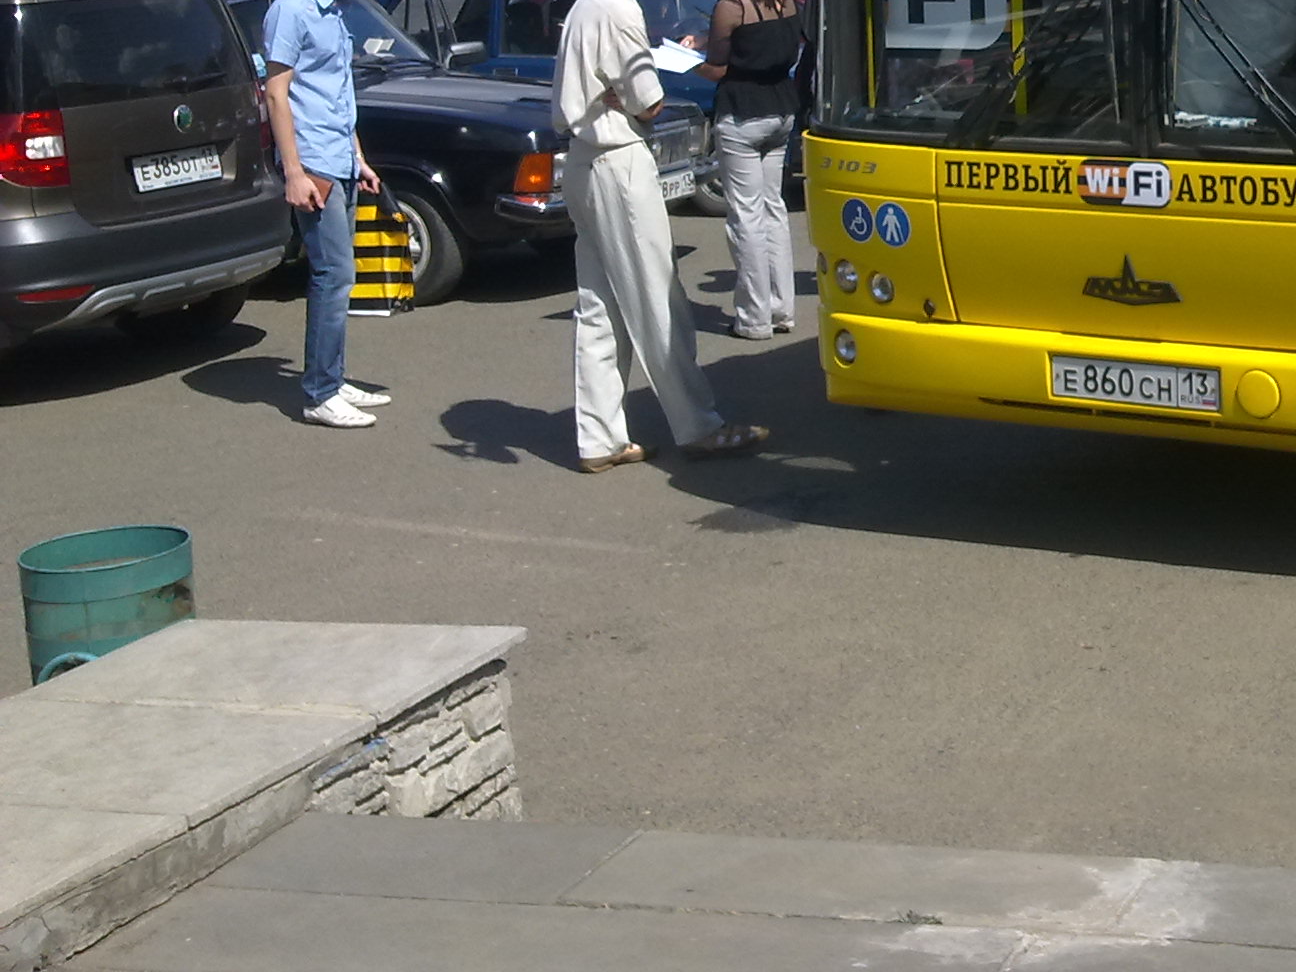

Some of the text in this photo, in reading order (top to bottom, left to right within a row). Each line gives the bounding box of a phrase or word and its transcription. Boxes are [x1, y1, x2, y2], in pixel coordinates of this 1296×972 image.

[944, 160, 1073, 195] ПЕРВЫЙ
[1063, 364, 1208, 403] Е860СН 13
[1180, 394, 1201, 406] RUS
